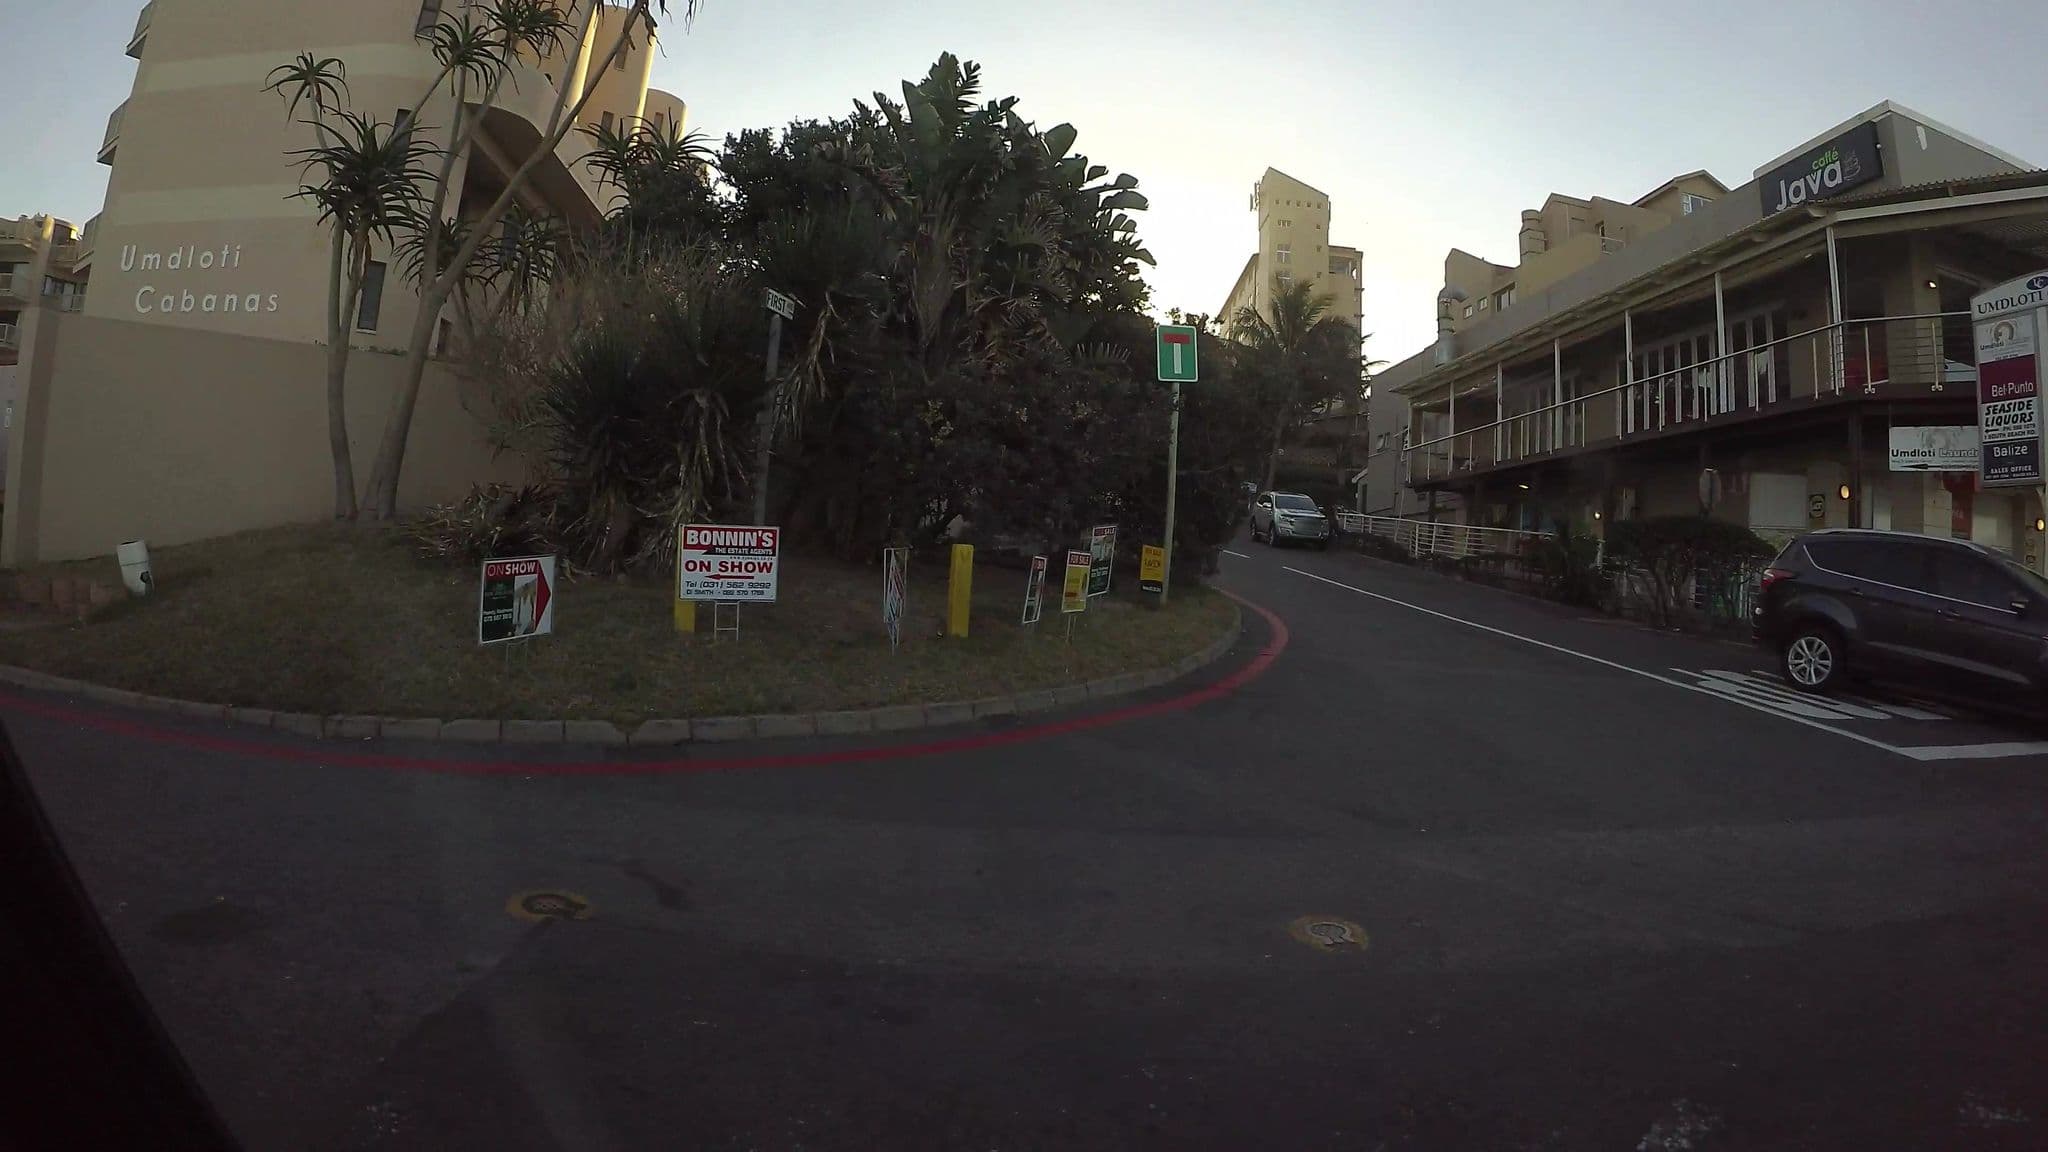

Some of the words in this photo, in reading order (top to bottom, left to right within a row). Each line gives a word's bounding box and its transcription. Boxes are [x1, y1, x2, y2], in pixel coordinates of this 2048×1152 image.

[1775, 160, 1844, 211] Java
[120, 244, 241, 272] Umdloti
[135, 285, 280, 314] Cabanas
[767, 290, 786, 313] FIRST
[1977, 290, 2044, 315] UMDLOTI
[1985, 399, 2033, 416] SEASIDE
[1985, 411, 2034, 428] LIQUORS
[1891, 448, 1936, 458] Umdloti
[1939, 447, 1979, 458] Laundr
[1993, 444, 2029, 458] Balize
[1990, 466, 2009, 475] SALES
[2010, 464, 2032, 473] OFFICE
[686, 529, 774, 548] BONNIN'S
[727, 547, 749, 555] ESTATE
[749, 548, 773, 556] AGENTS
[685, 560, 712, 573] ON
[718, 560, 773, 574] SHOW
[685, 580, 697, 588] Tel
[700, 580, 723, 589] (031)
